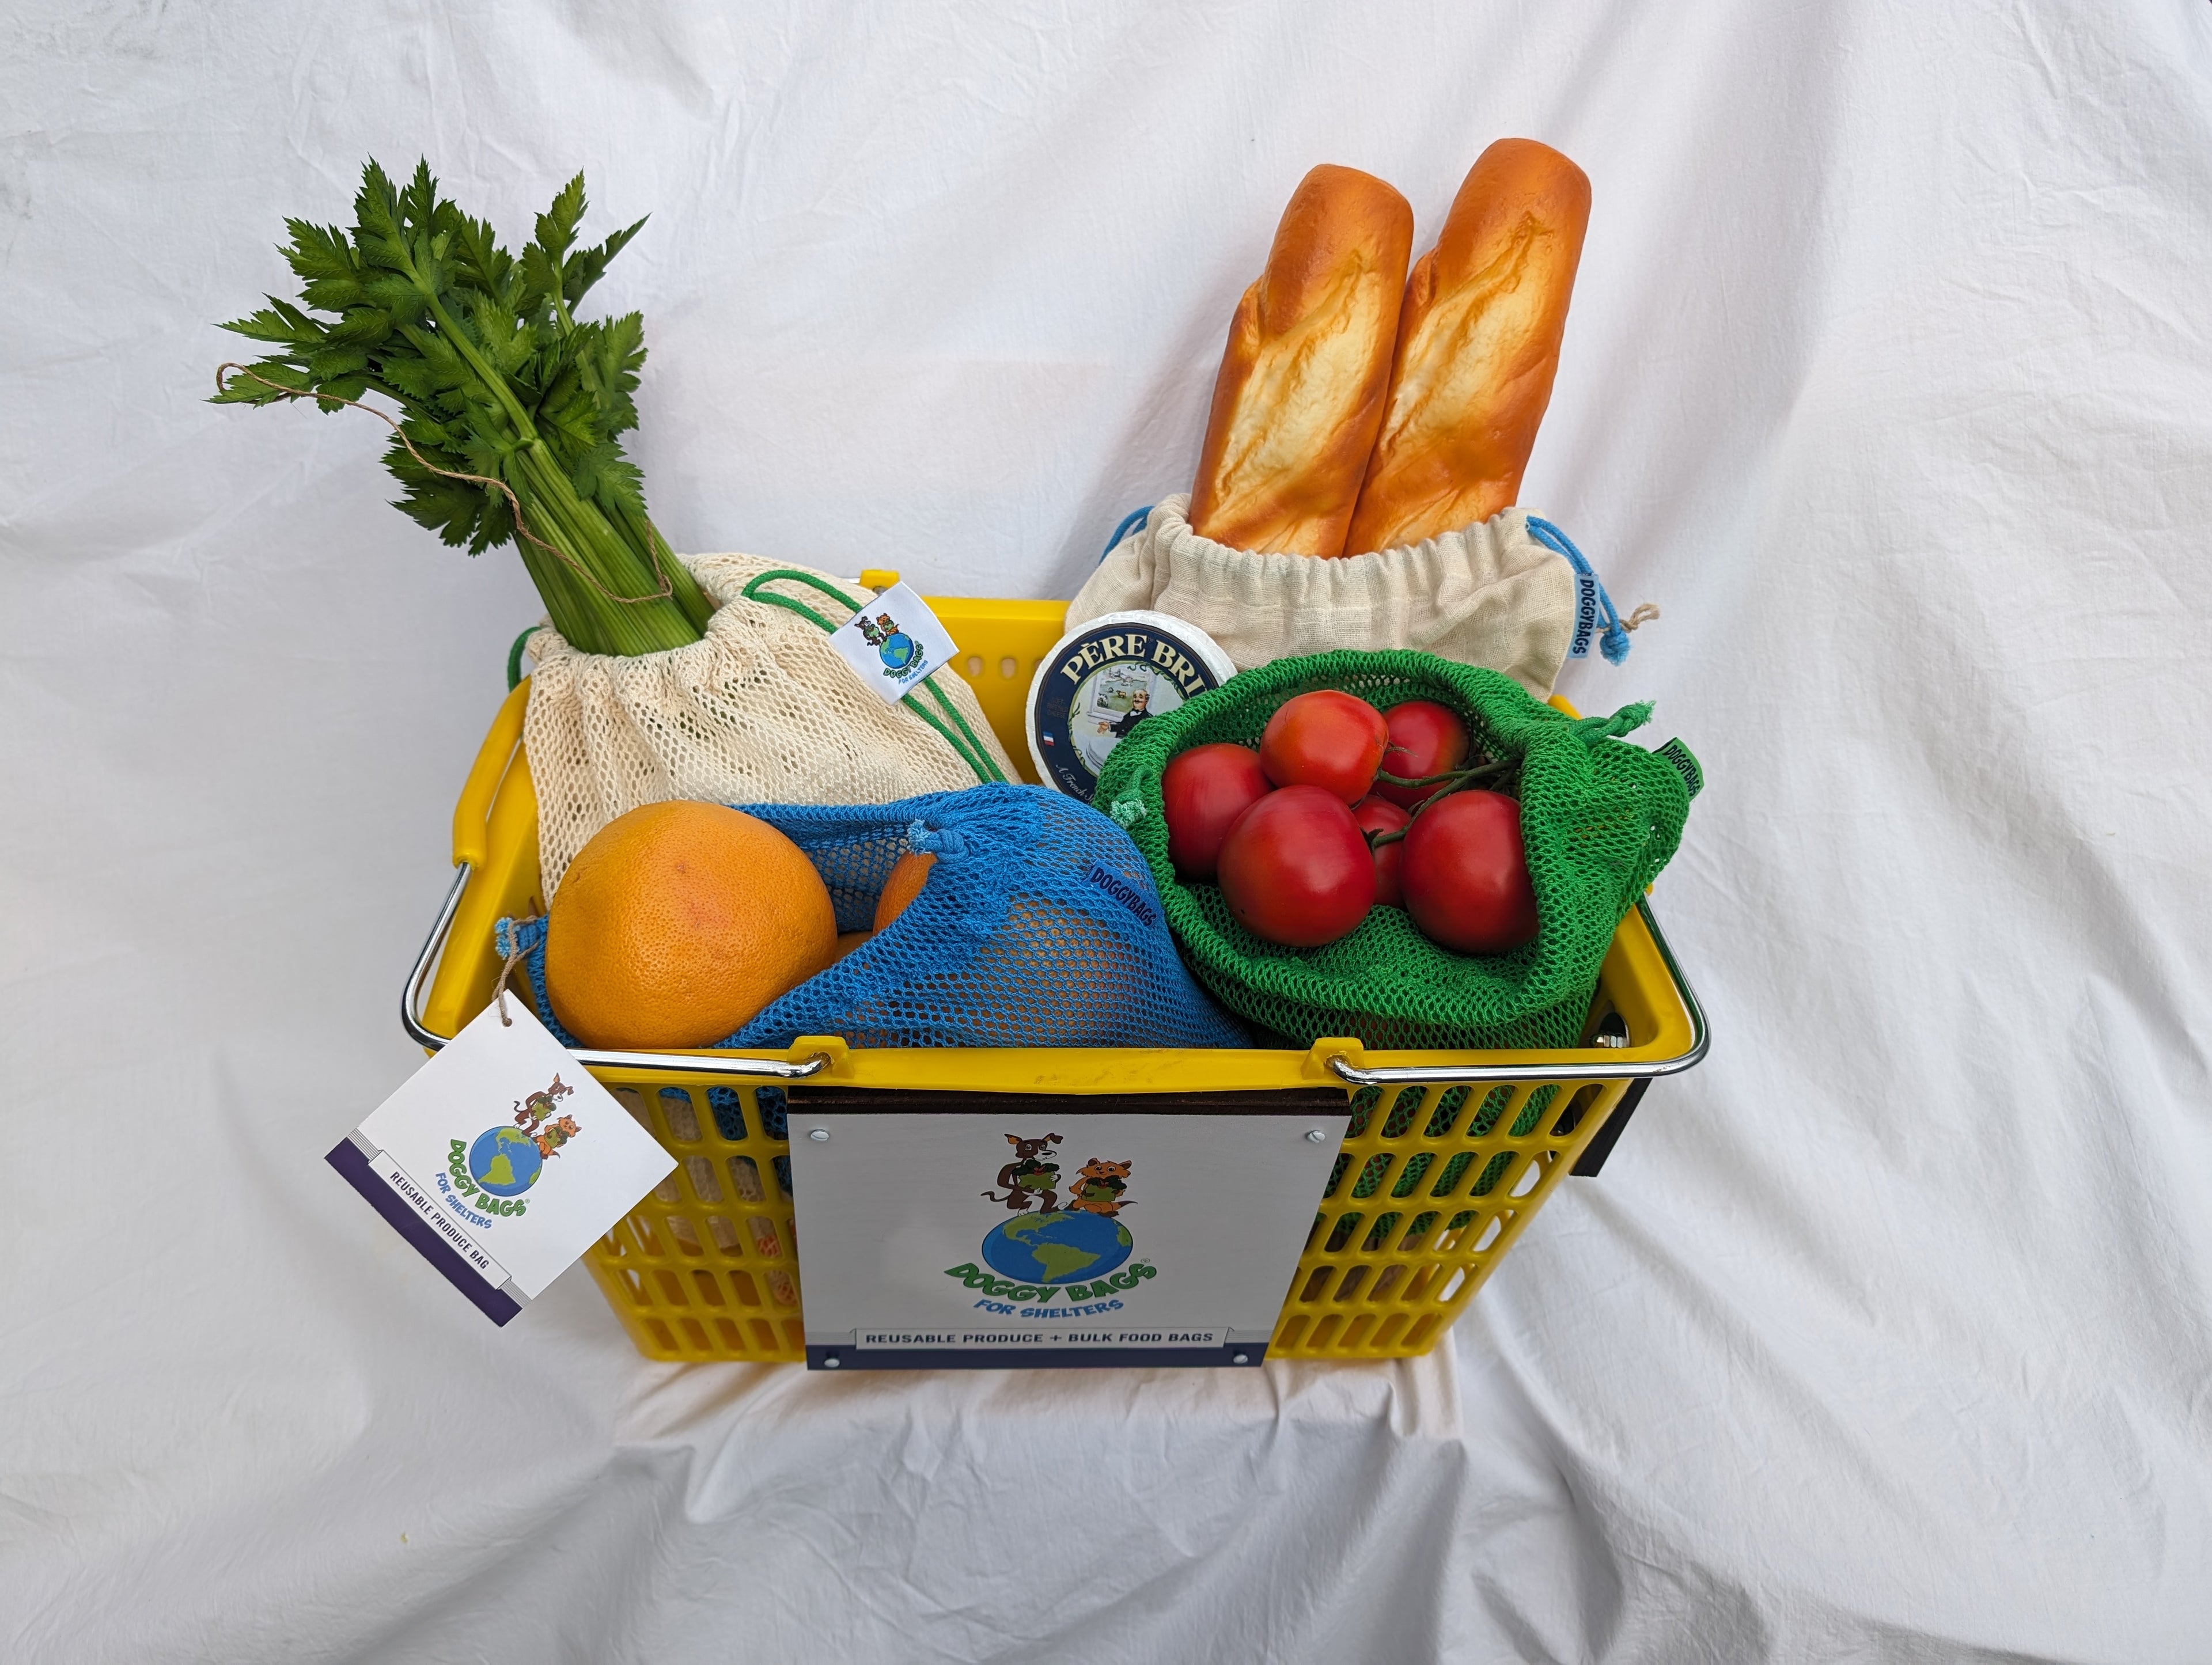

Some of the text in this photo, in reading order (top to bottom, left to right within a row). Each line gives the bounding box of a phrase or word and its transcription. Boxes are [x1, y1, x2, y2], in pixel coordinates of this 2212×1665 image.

[1572, 579, 1596, 654] DOGGYBAGS
[883, 665, 911, 679] DOGGY
[898, 677, 908, 685] FOR
[1060, 634, 1207, 699] PÈRE BRI
[1662, 744, 1700, 797] DOGGYBAGS
[1090, 867, 1157, 926] DOGGYBAGS
[448, 1139, 480, 1198] DOGGY
[390, 1171, 489, 1269] REUSABLE PRODUCE BAG
[435, 1172, 493, 1229] FOR SHELTERS
[944, 1262, 1062, 1303] DOGGY
[973, 1299, 1124, 1318] FOR SHELTERS
[865, 1334, 956, 1343] REUSABLE
[963, 1334, 1043, 1343] PRODUCE
[1067, 1333, 1113, 1342] BULK
[1119, 1333, 1162, 1342] FOOD
[1168, 1333, 1214, 1342] BAGS
